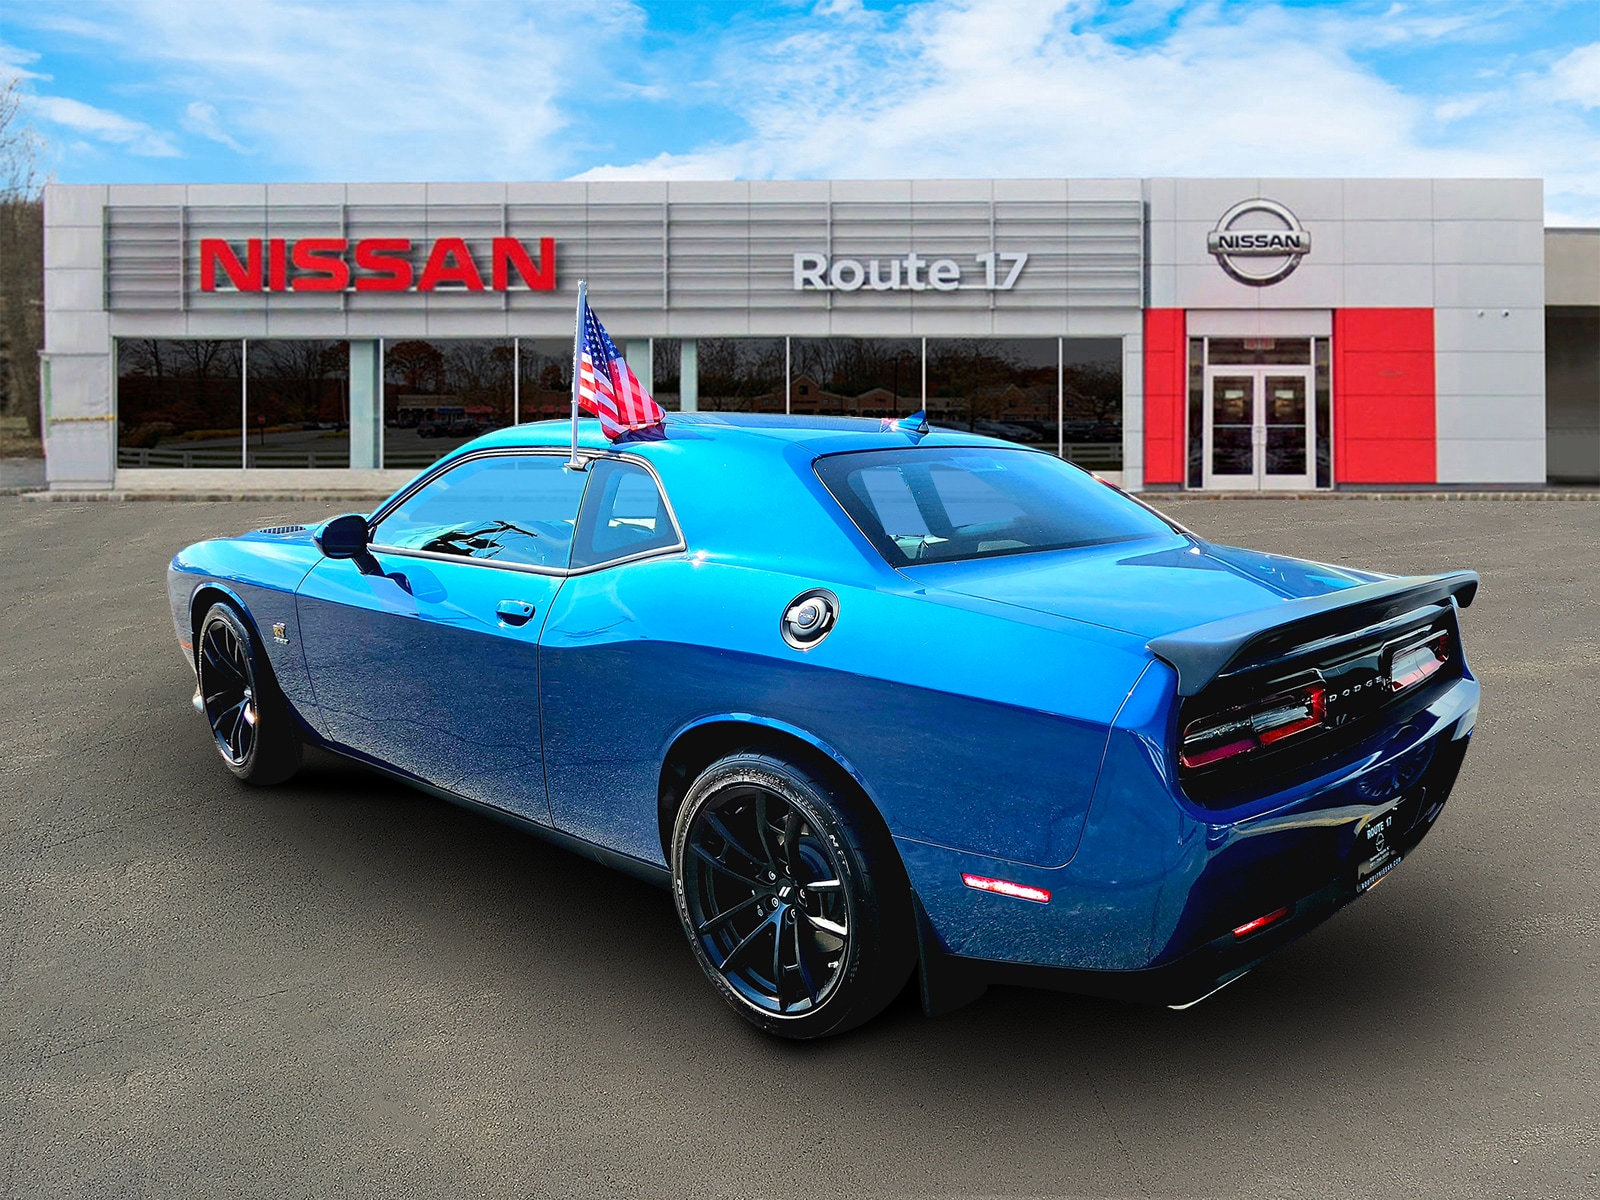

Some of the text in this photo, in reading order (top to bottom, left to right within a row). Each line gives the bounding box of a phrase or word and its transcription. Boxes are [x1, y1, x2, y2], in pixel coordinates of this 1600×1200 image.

[1219, 234, 1301, 248] NISSAN
[200, 237, 556, 292] NISSAN
[793, 252, 1028, 291] Route 17
[1328, 675, 1382, 702] DODGE
[1366, 816, 1392, 839] ROUTE 17
